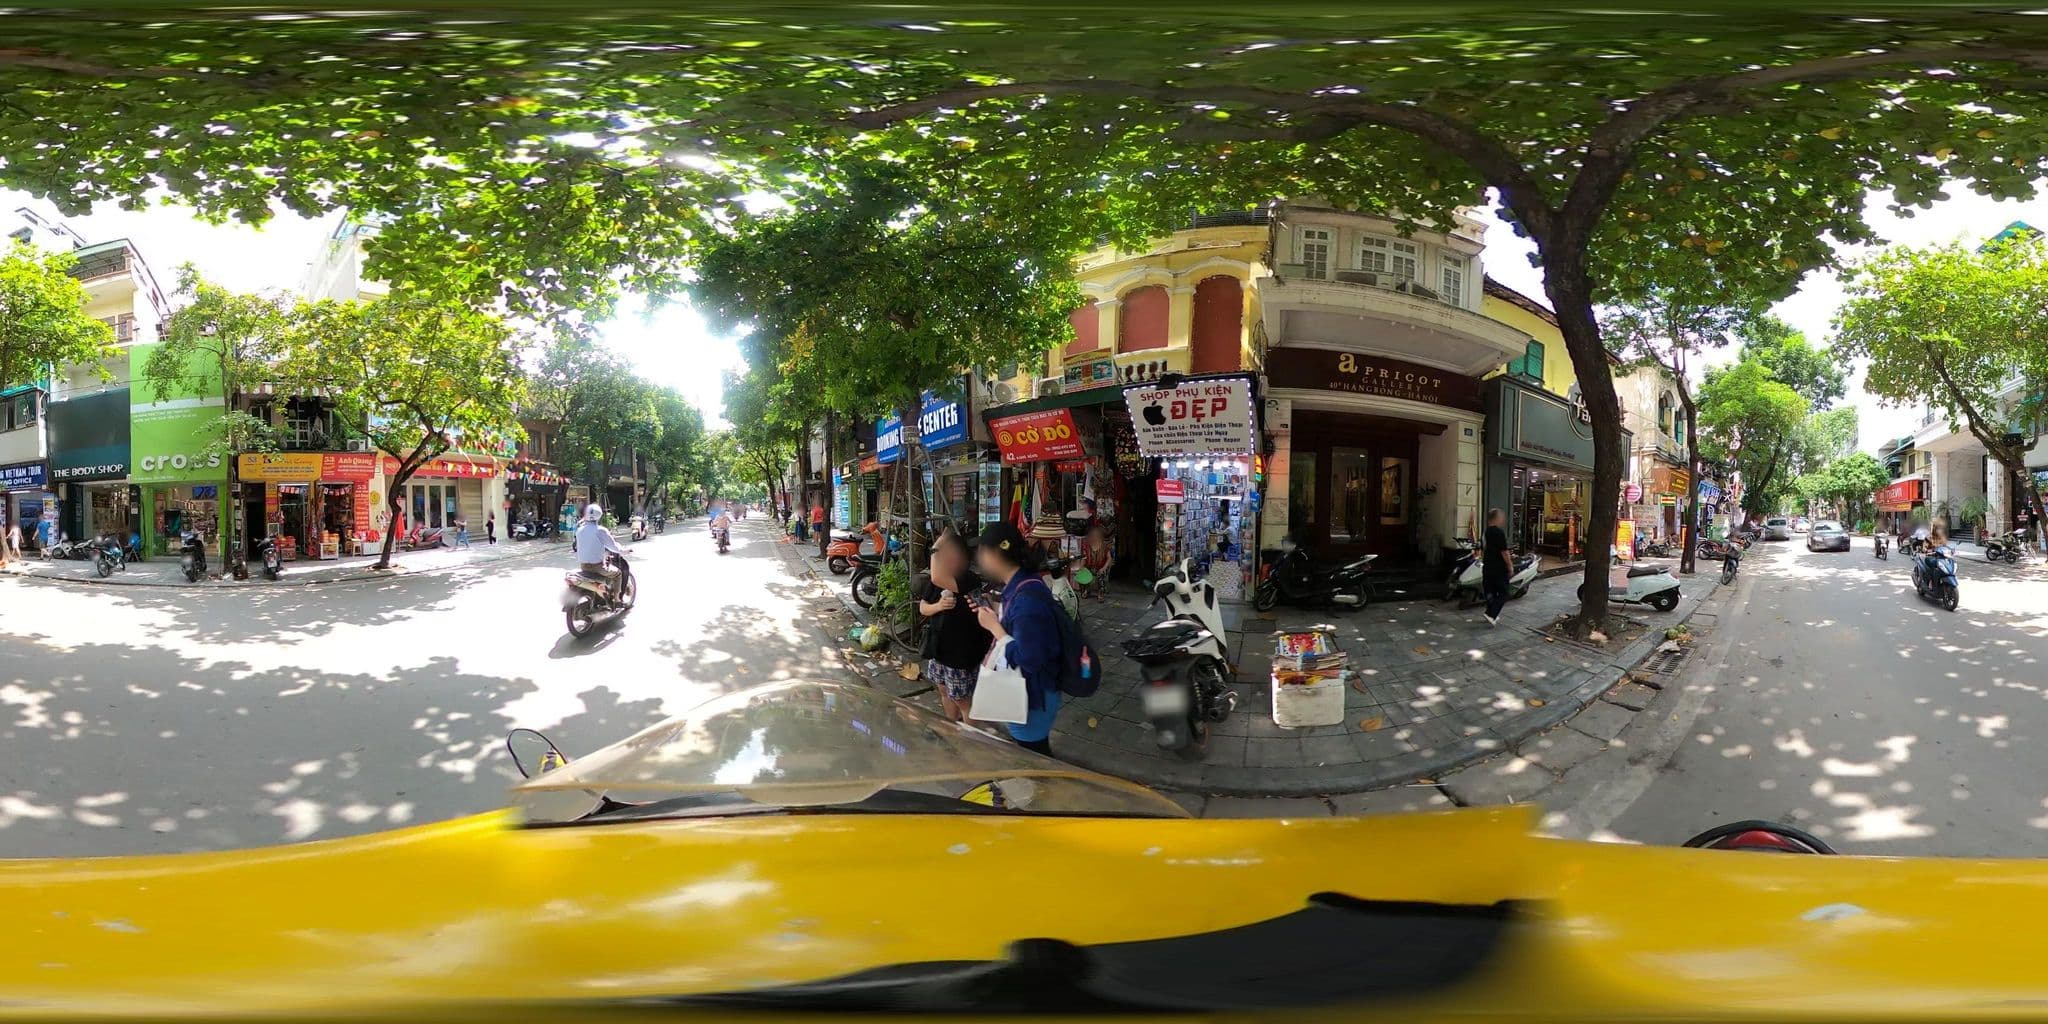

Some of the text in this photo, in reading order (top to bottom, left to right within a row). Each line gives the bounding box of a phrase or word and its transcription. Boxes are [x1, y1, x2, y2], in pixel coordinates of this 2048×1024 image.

[1361, 376, 1421, 392] GALLERY
[1140, 384, 1232, 402] SHOP PHỤ KIỆN
[1170, 397, 1227, 422] ĐẸP
[923, 402, 958, 435] CENTER
[1016, 418, 1071, 445] CỜ ĐỎ
[338, 456, 353, 464] Anh
[1006, 452, 1015, 460] 42
[5, 467, 27, 478] VIETNAM
[28, 465, 42, 475] TOUR
[53, 464, 124, 478] THE BODY SHOP
[13, 477, 32, 485] OFFICE
